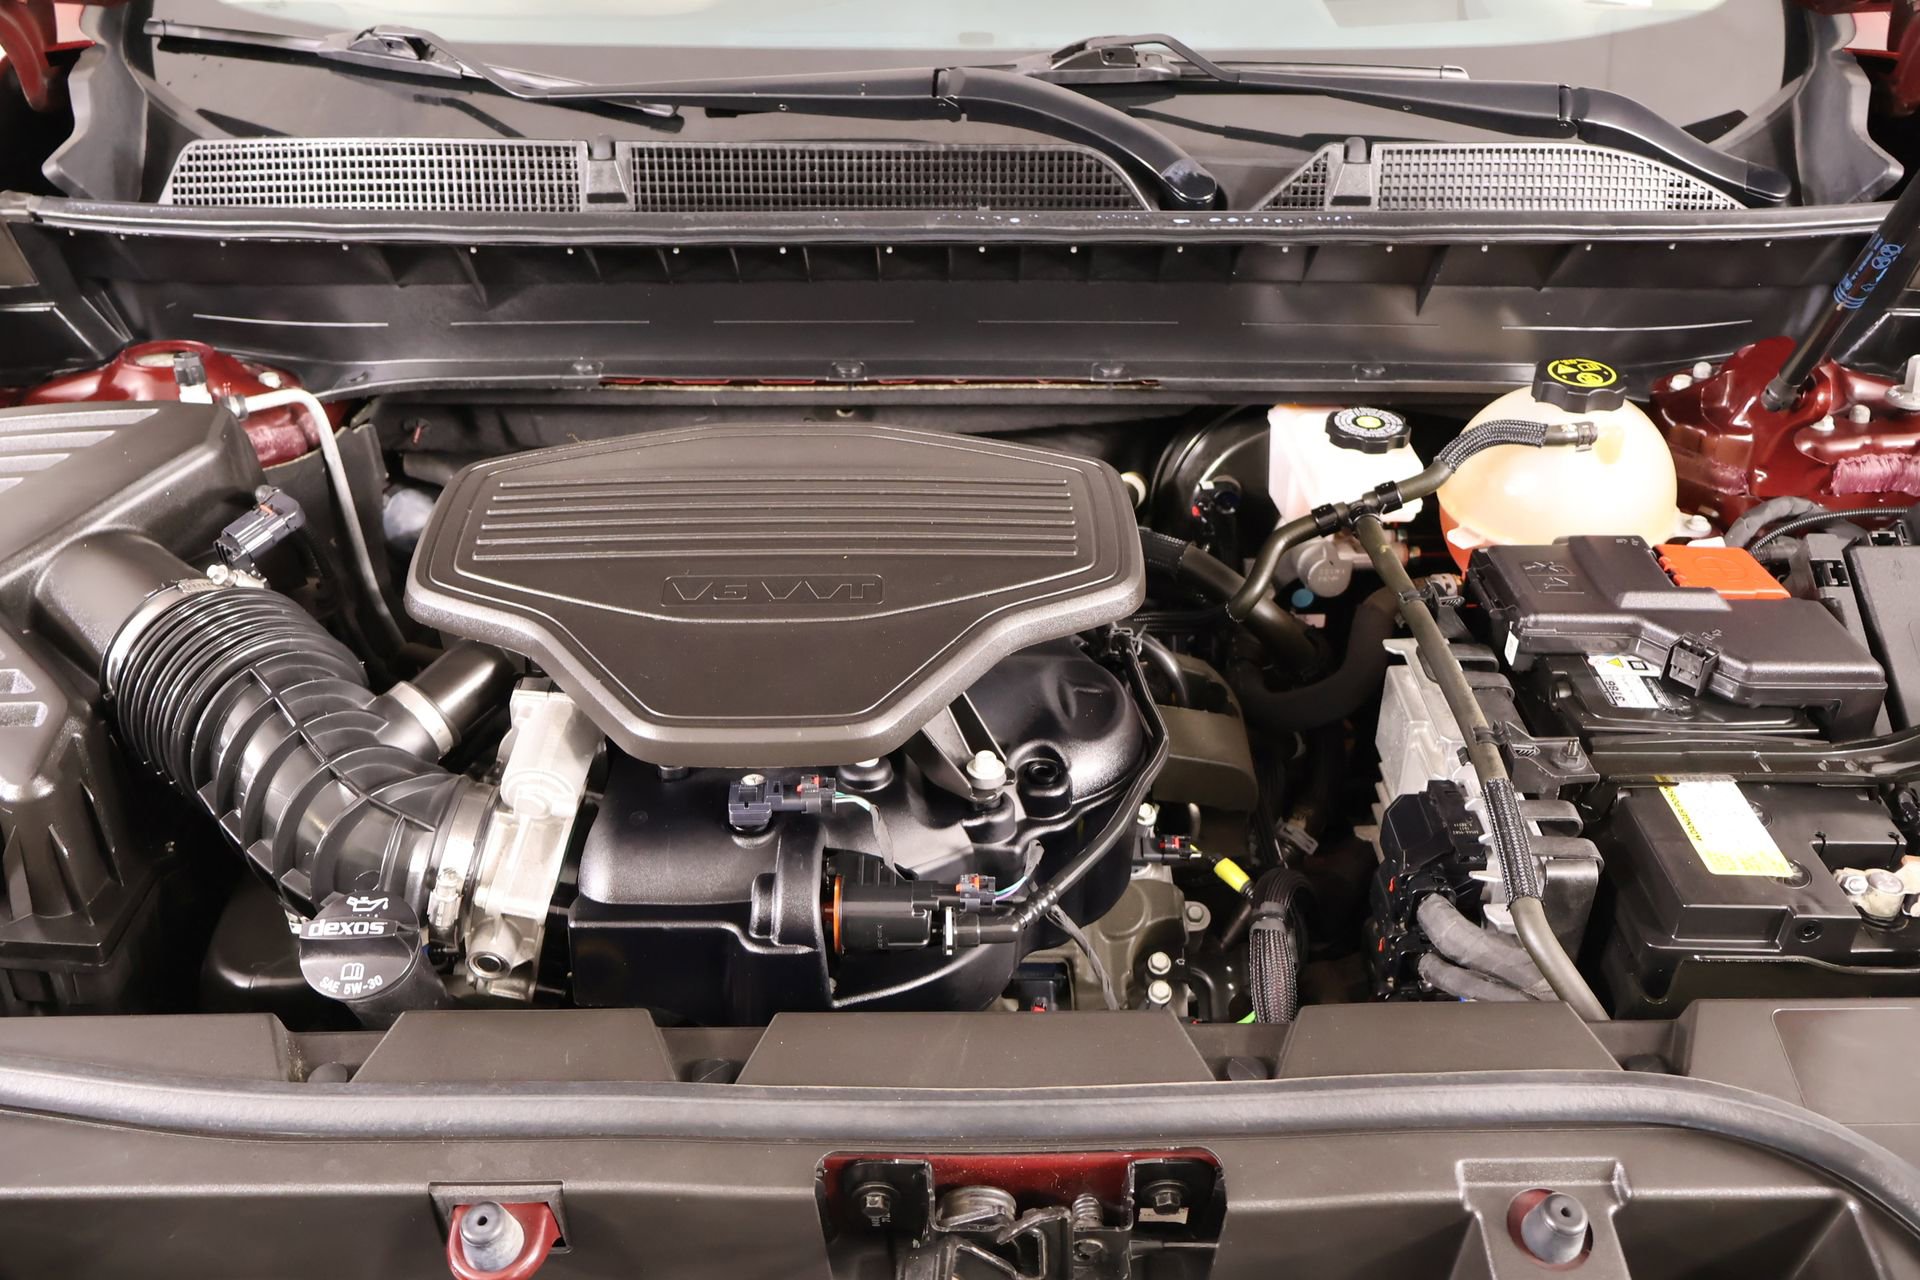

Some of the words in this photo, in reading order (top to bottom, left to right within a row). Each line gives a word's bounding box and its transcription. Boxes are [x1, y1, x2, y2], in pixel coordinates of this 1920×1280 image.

[672, 581, 747, 600] V6
[761, 580, 876, 600] VVT
[308, 919, 386, 937] dexos
[320, 976, 340, 993] SAE
[343, 975, 383, 995] 5W-30
